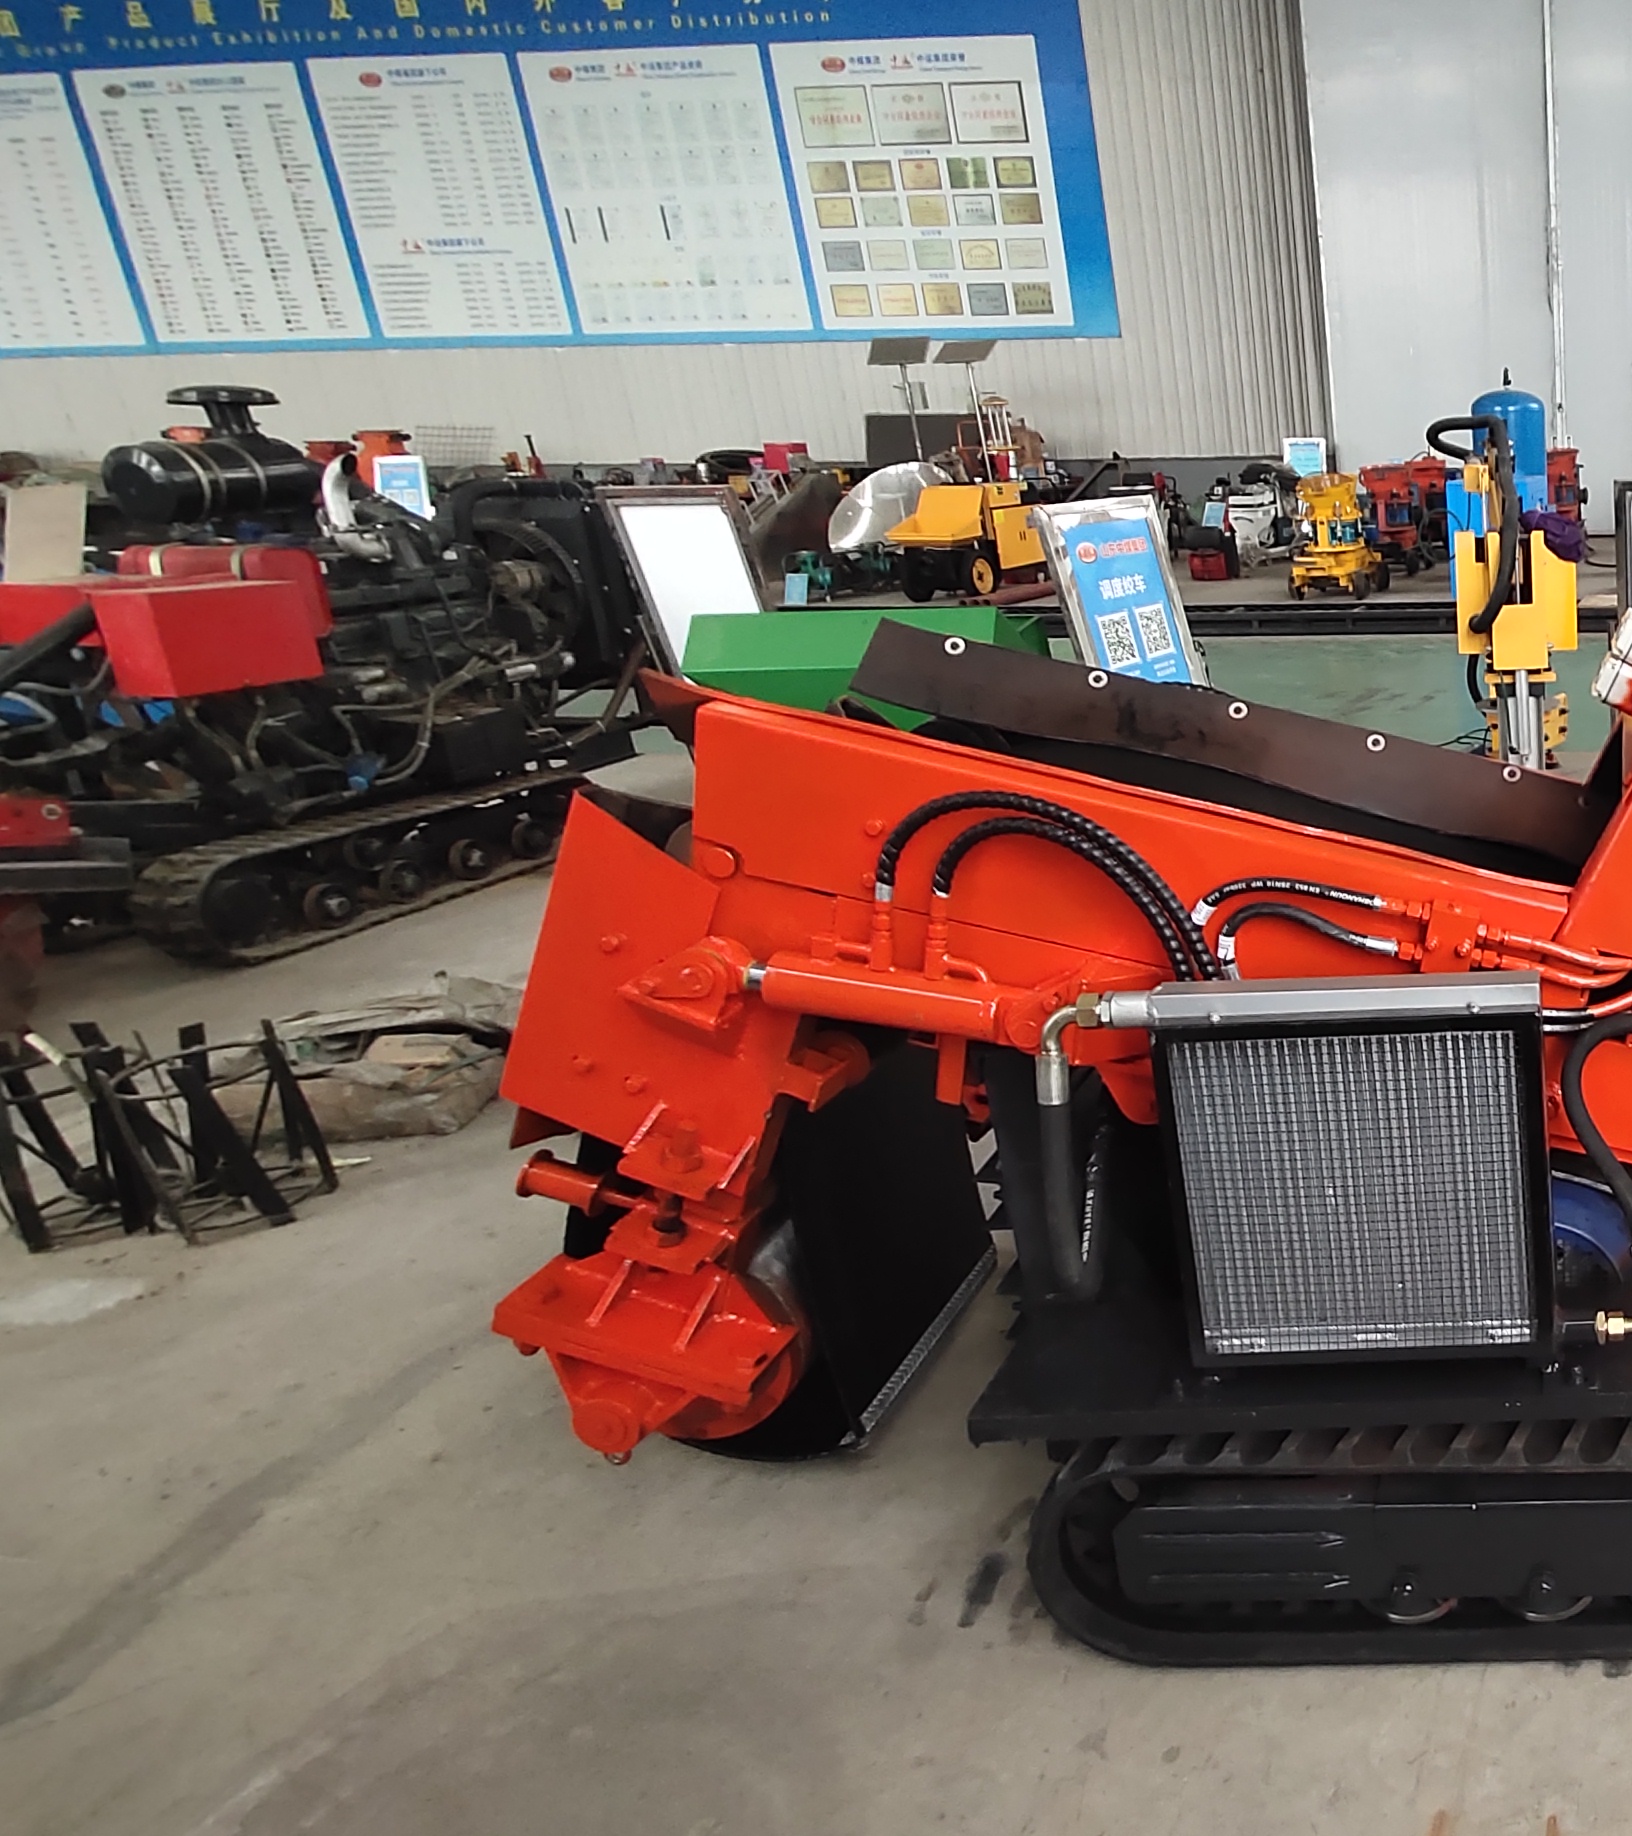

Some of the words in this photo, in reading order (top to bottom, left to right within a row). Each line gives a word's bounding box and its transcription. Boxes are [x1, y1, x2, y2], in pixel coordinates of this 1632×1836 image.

[107, 34, 199, 50] Product
[211, 29, 342, 46] Exhibition
[357, 26, 400, 40] And
[412, 21, 527, 39] Domestic
[541, 15, 655, 34] Customer
[670, 9, 832, 30] Distribution
[1098, 574, 1147, 600] 调度绞车
